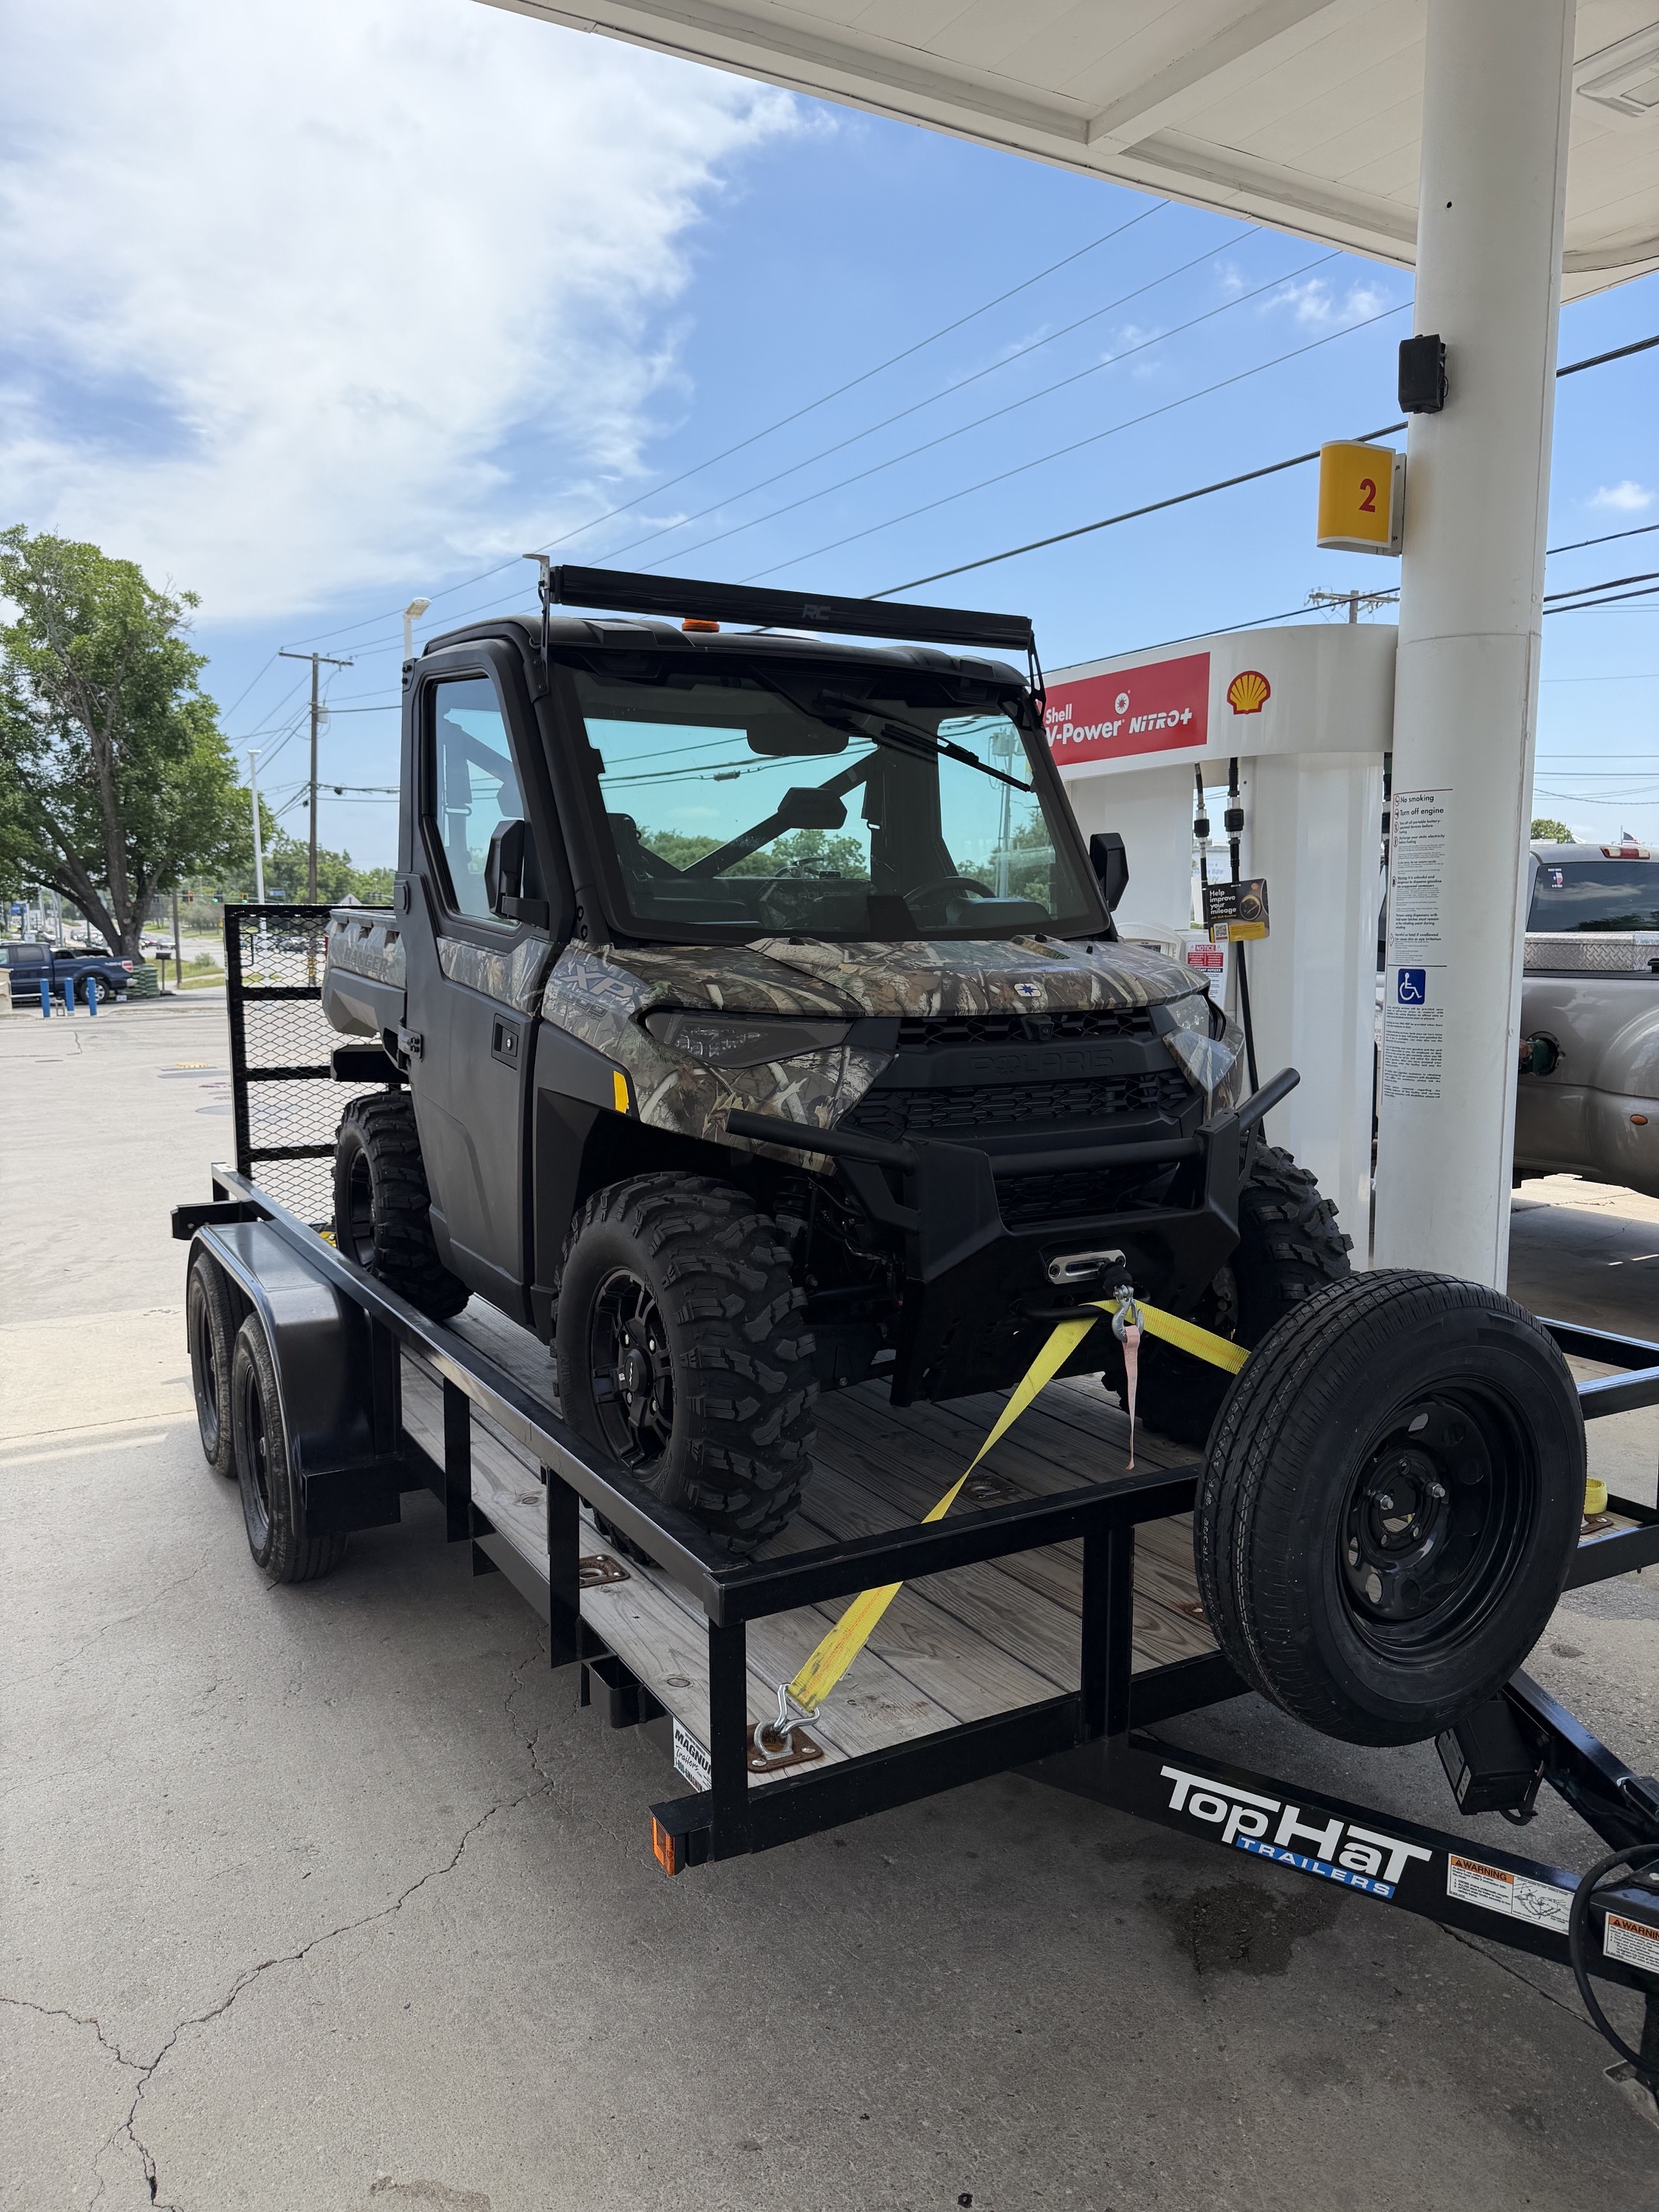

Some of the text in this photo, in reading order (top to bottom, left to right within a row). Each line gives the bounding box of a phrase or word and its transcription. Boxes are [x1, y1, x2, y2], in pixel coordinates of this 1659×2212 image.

[1358, 479, 1376, 513] 2
[1046, 703, 1072, 724] Shell
[1046, 720, 1122, 747] V-Power
[1421, 807, 1444, 816] engine
[344, 947, 387, 971] RANGER
[559, 964, 634, 998] XP
[970, 1049, 1114, 1075] POLARIS
[1241, 1837, 1389, 1896] TRAILERS
[1463, 1860, 1507, 1881] WARNING
